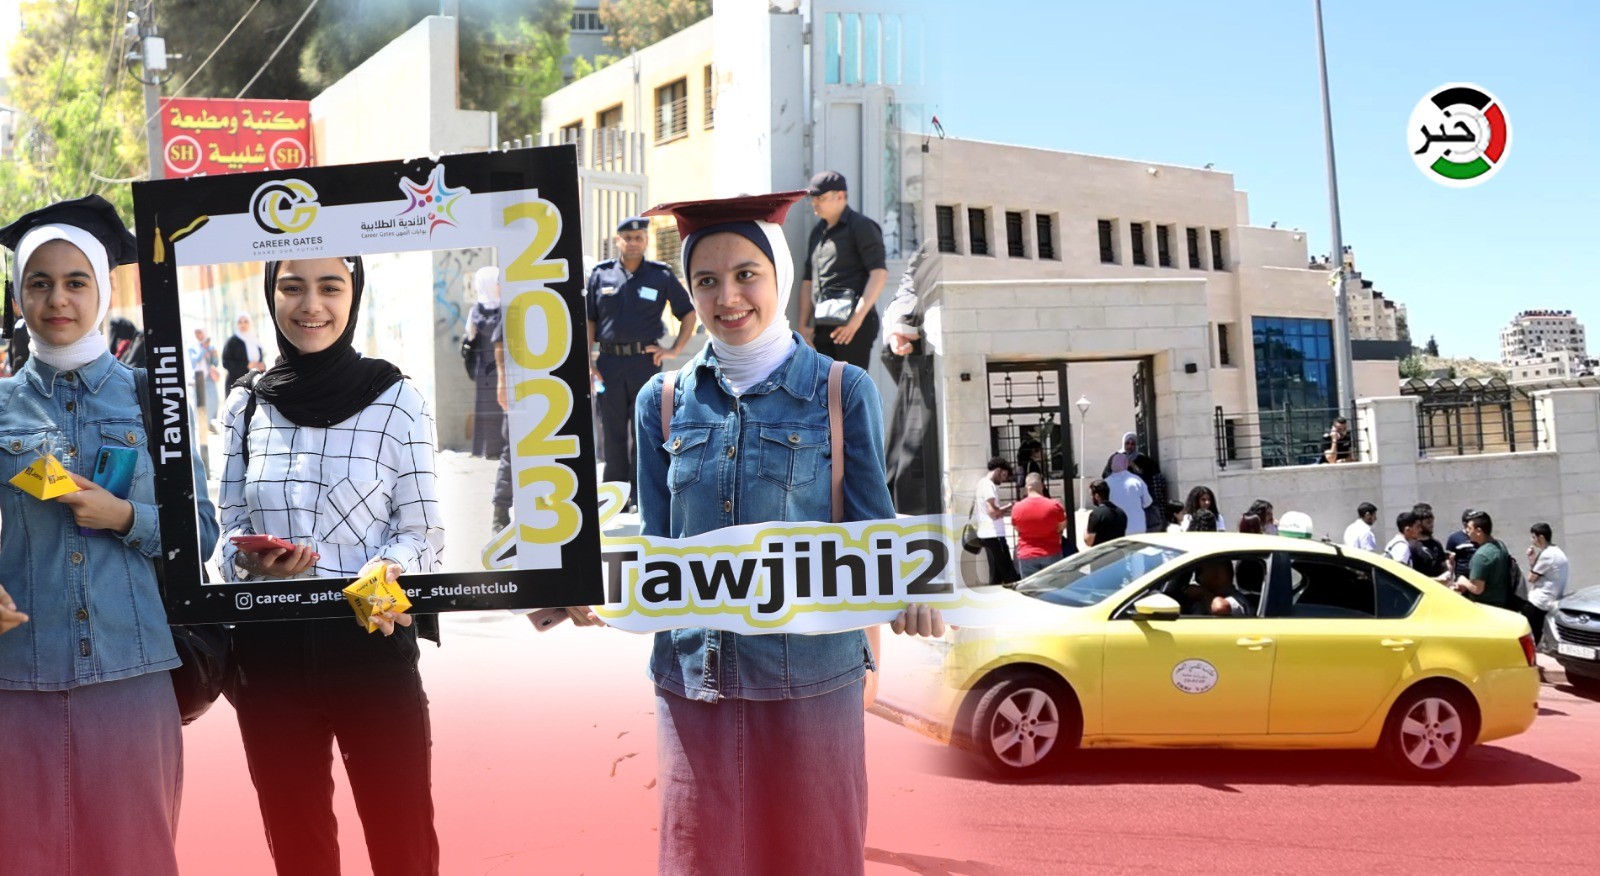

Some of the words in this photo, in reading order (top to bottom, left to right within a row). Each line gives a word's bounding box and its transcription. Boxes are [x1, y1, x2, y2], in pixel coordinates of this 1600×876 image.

[170, 107, 239, 135] ومطبعة
[241, 108, 306, 135] مكتبة
[170, 145, 195, 161] SH
[208, 142, 266, 169] شلبية
[276, 148, 300, 164] SH
[360, 219, 396, 232] الطلابية
[398, 214, 426, 229] الأندية
[252, 239, 291, 249] CAREER
[293, 236, 323, 246] GATES
[503, 201, 582, 546] 2023
[153, 346, 185, 465] Tawjihi
